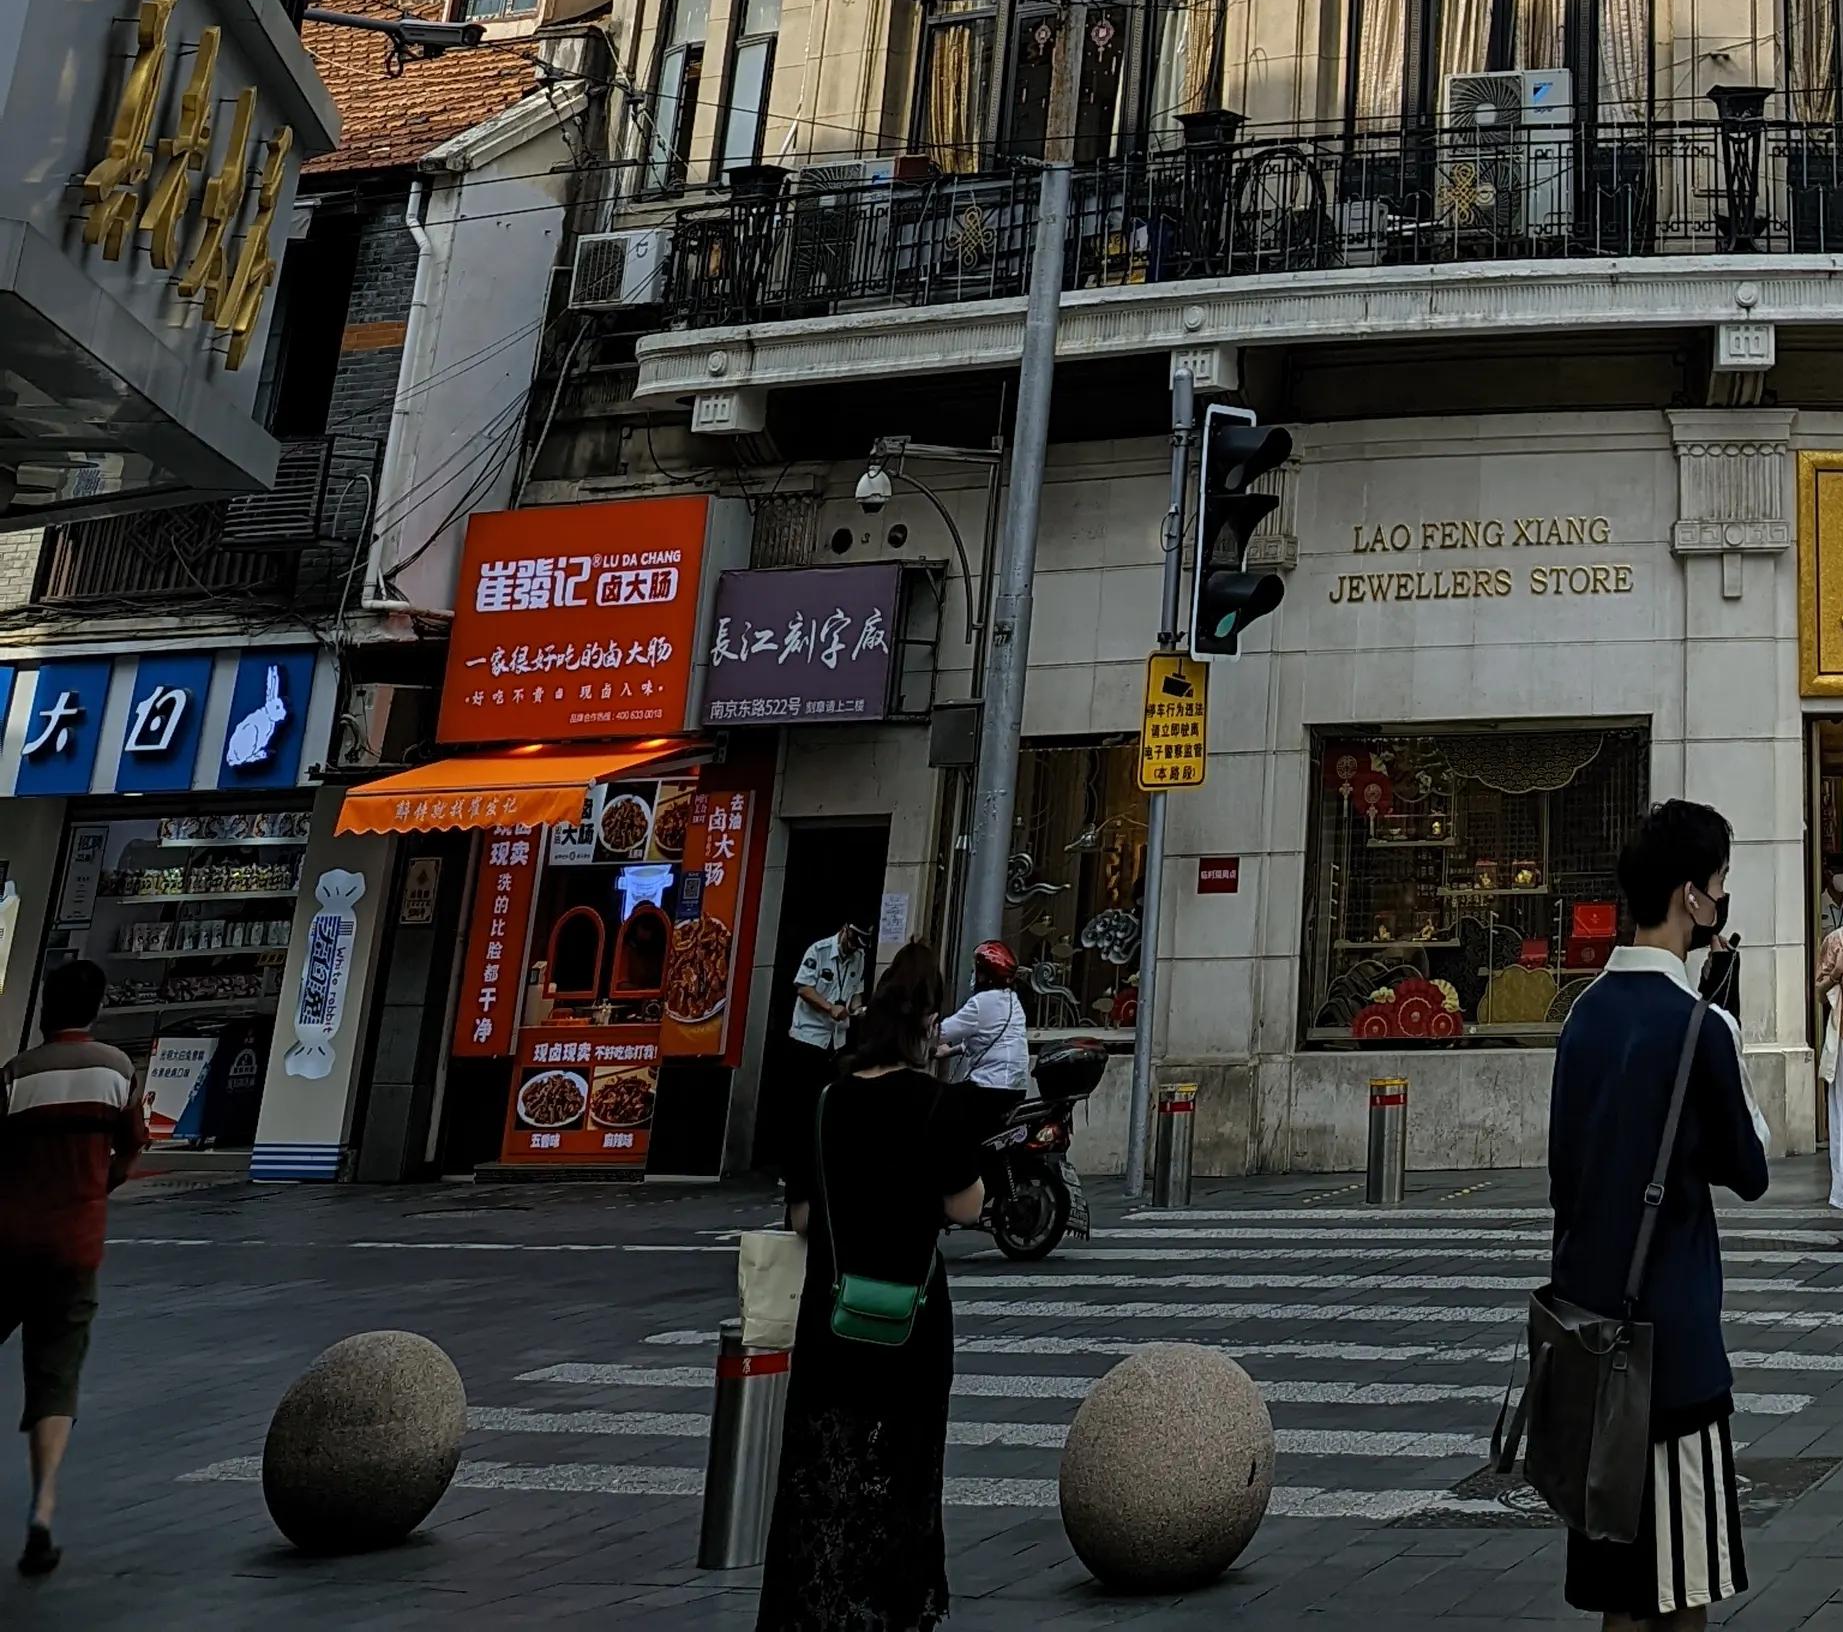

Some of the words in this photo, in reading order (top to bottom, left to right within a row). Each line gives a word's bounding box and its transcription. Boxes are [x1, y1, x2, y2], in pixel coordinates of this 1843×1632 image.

[1353, 523, 1411, 553] LAO
[1421, 519, 1506, 550] FENG
[1512, 515, 1612, 547] XIANG
[602, 552, 619, 568] LU
[622, 551, 638, 567] DA
[640, 548, 681, 566] CHANG
[599, 570, 674, 604] 卤大肠
[1329, 567, 1513, 604] JEWELLERS
[1530, 564, 1634, 595] STORE
[465, 636, 673, 678] 一家很好吃的卤大肠
[709, 696, 802, 720] 南京东路522号
[1146, 702, 1205, 718] 停车行为违法
[1150, 722, 1200, 739] 请立即驶离
[1144, 743, 1203, 760] 电子警察监管
[472, 872, 514, 1044] 洗的比脸都干净
[322, 991, 337, 1034] rabbit
